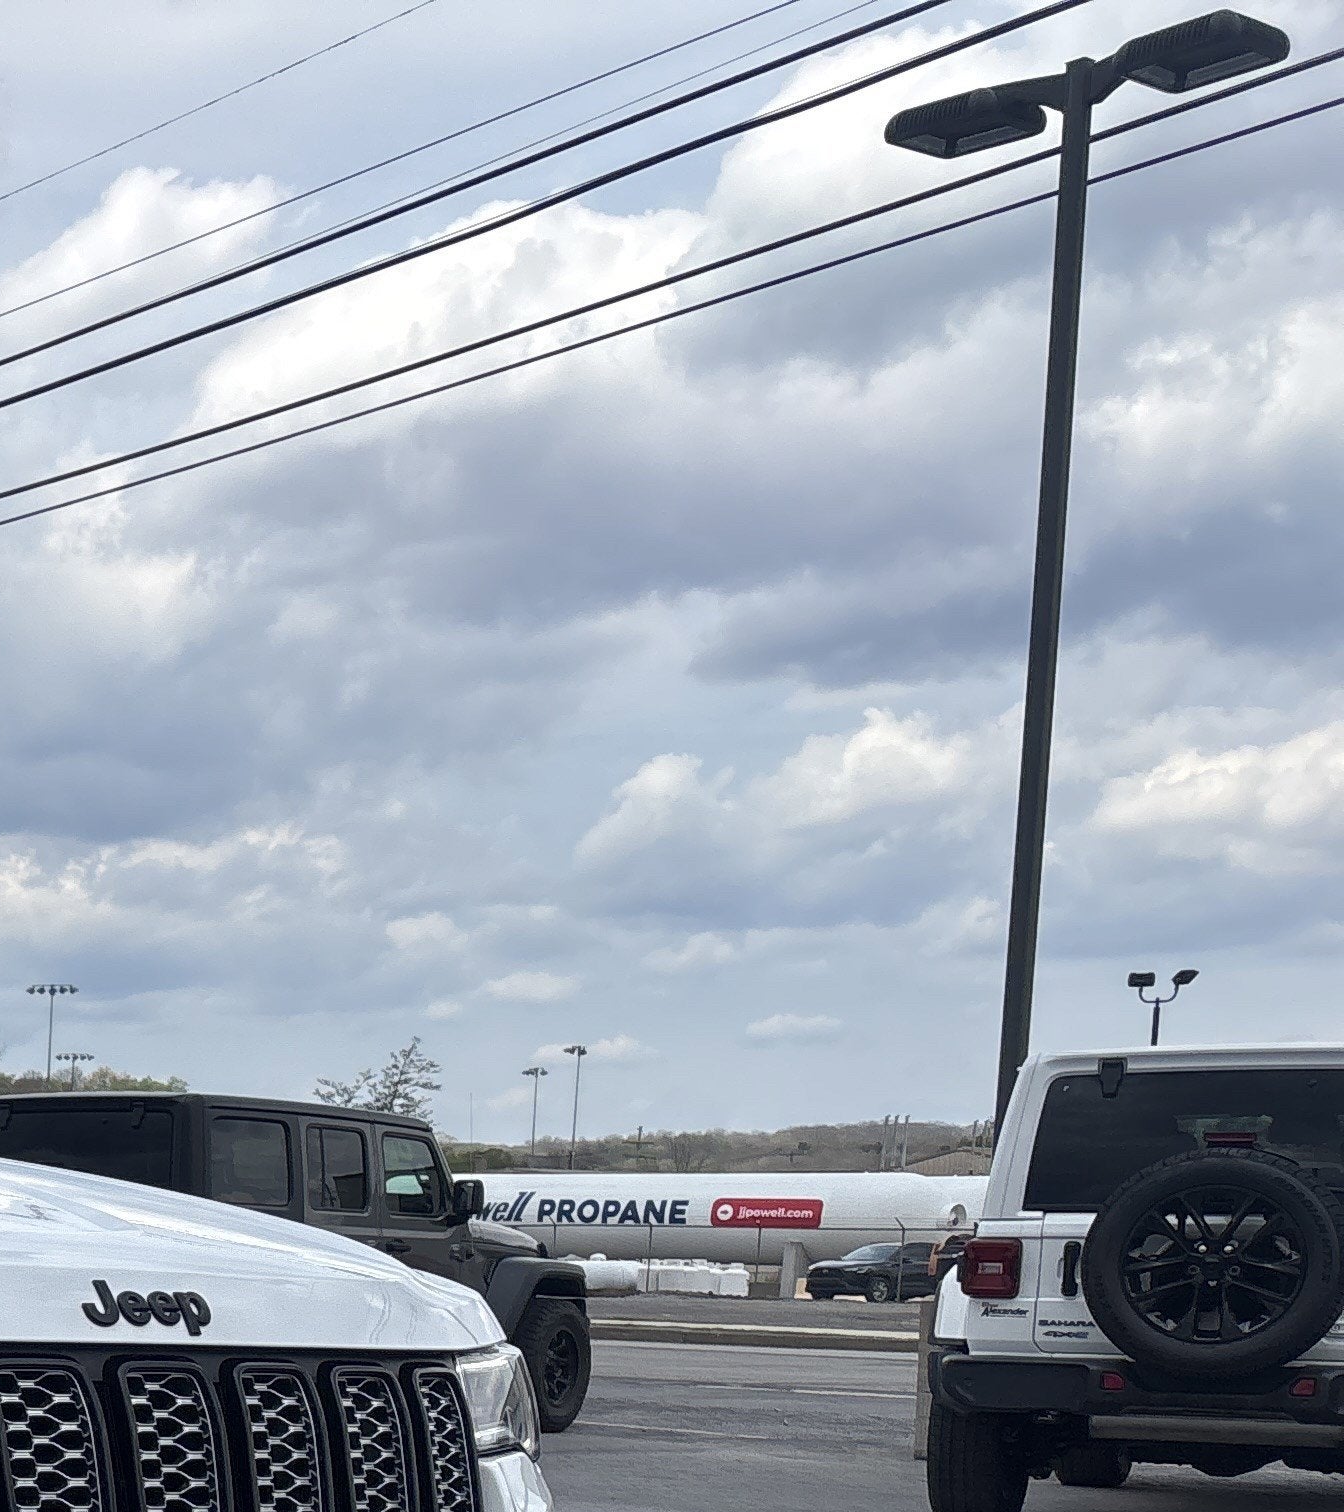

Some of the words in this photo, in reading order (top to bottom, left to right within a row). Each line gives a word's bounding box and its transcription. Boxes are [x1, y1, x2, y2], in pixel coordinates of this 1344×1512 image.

[537, 1199, 689, 1224] PROPANE
[81, 1279, 212, 1337] Jeep
[1038, 1319, 1095, 1327] SAHARA
